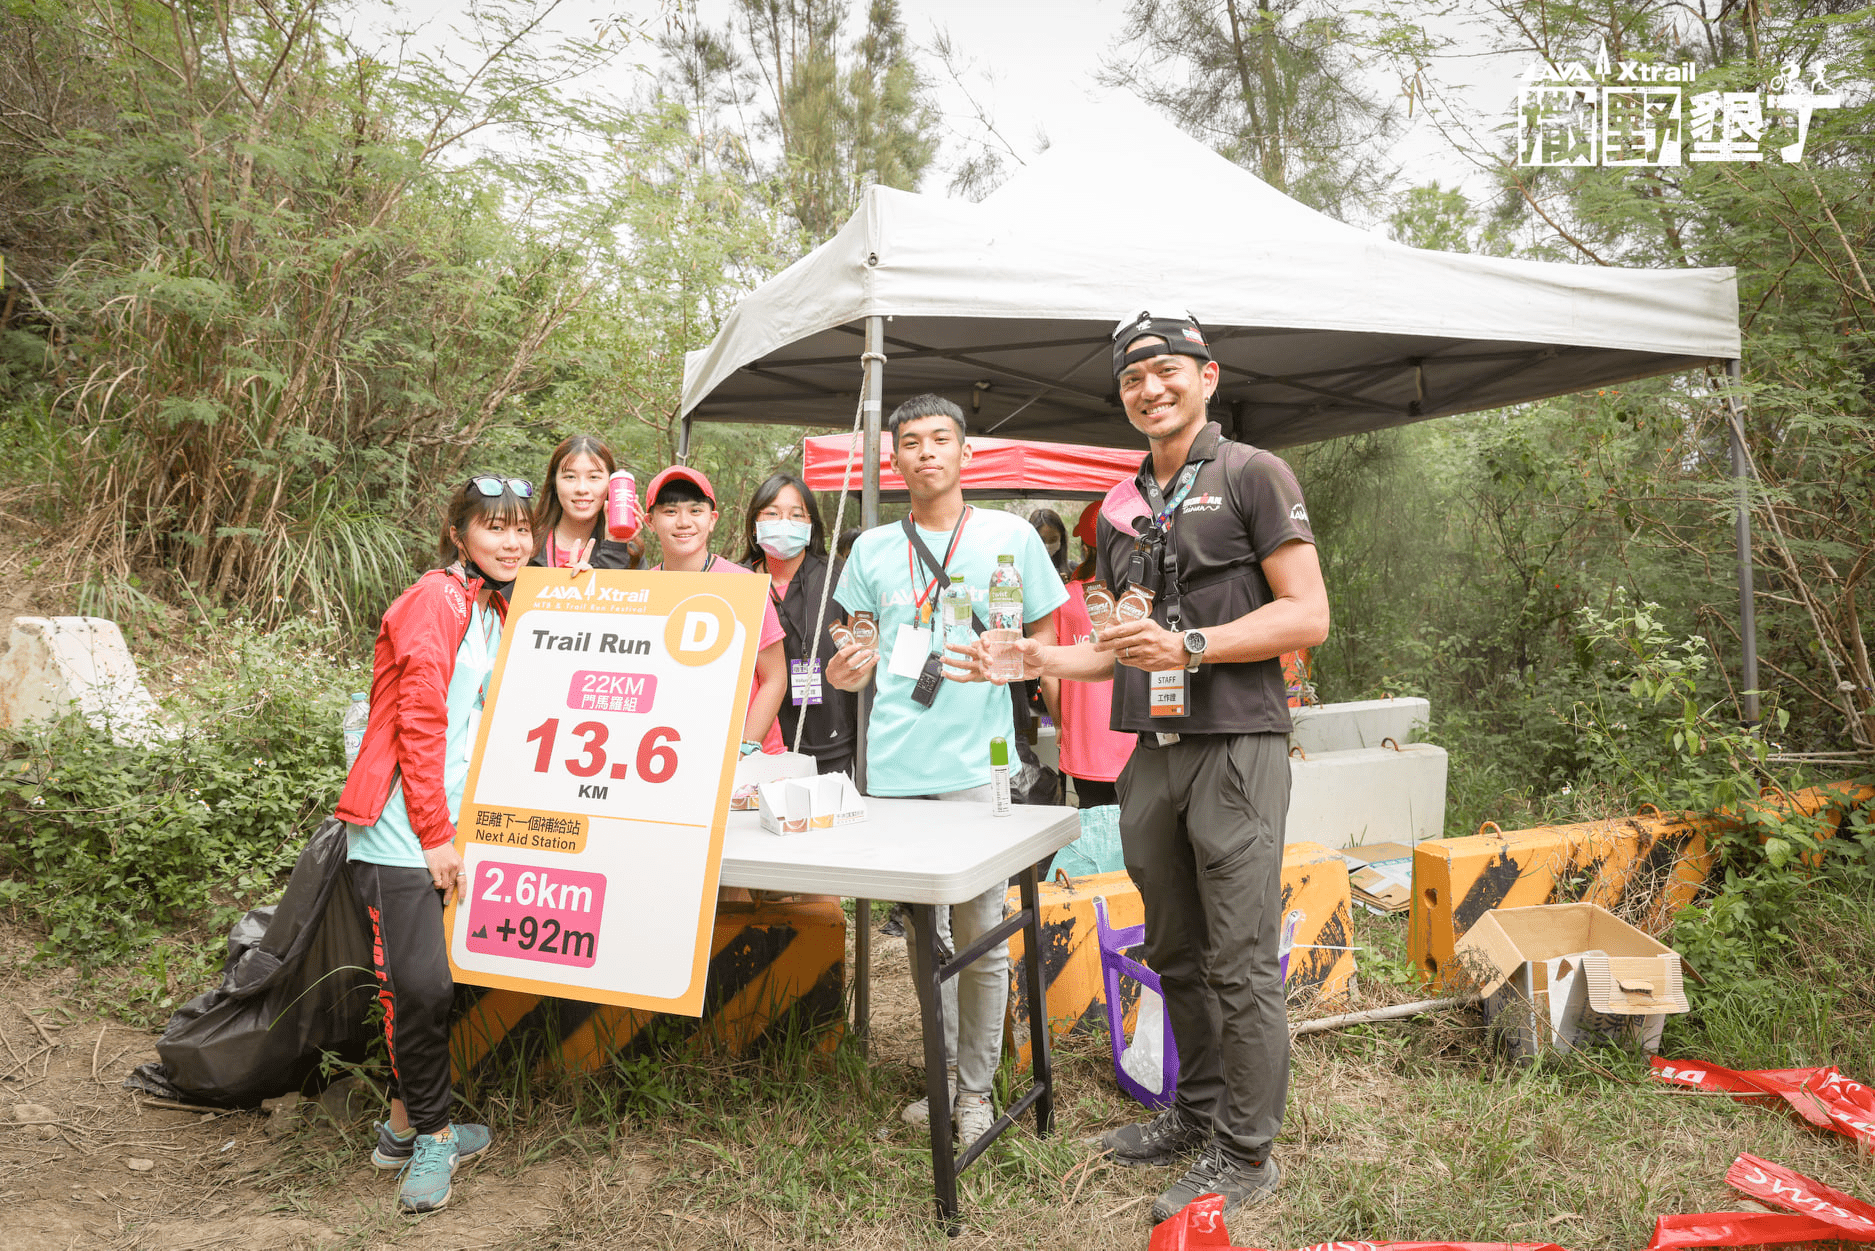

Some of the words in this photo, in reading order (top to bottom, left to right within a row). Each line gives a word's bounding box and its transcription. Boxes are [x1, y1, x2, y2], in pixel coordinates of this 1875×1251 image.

[536, 585, 582, 600] LAVA
[597, 587, 650, 603] Xtrail
[533, 601, 551, 609] MTB
[566, 602, 586, 611] Trail
[590, 603, 607, 612] Run
[610, 604, 647, 613] Festival
[532, 629, 592, 652] Trail
[599, 633, 651, 655] Run
[679, 611, 720, 652] D
[581, 674, 646, 696] 22KM
[1157, 675, 1177, 684] STAFF
[581, 694, 638, 713] 門馬羅組
[525, 717, 681, 784] 13.6
[578, 784, 609, 800] KM
[475, 810, 582, 836] 距離下一個補給站
[475, 829, 505, 844] Next
[507, 832, 528, 846] Aid
[530, 834, 577, 851] Station
[481, 867, 594, 913] 2.6km
[495, 915, 595, 959] +92m
